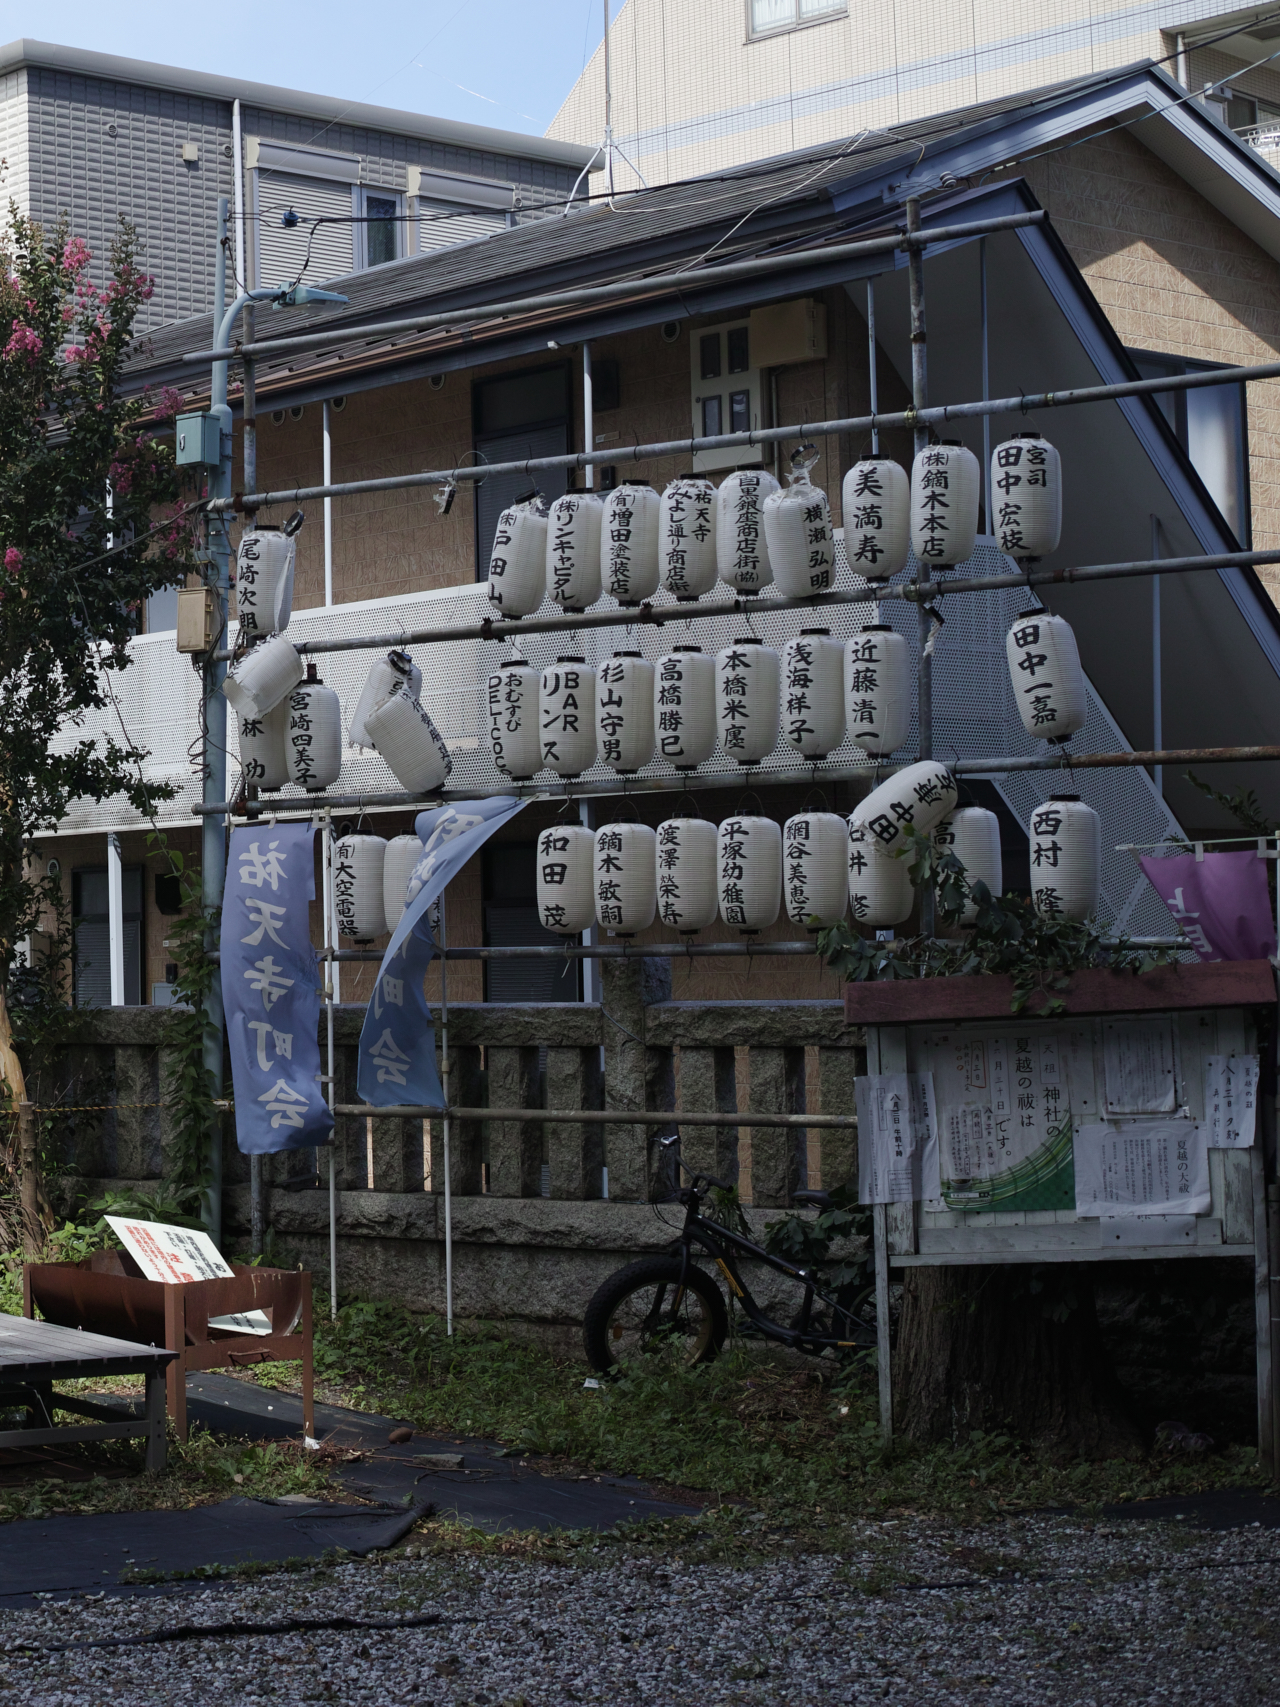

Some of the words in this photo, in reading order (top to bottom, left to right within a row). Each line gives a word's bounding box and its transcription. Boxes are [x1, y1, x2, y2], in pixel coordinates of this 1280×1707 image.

[1026, 445, 1048, 487] 宮司
[665, 486, 693, 593] みよし通り商店街
[691, 489, 713, 543] 祐天寺
[803, 504, 830, 590] 横瀬弘明
[853, 467, 884, 564] 美満寿
[504, 673, 523, 732] おむすび
[543, 672, 562, 762] リンス
[562, 671, 580, 733] BAR
[599, 663, 625, 762] 杉山守男
[785, 642, 815, 744] 浅海祥子
[850, 638, 881, 739] 近藤清一
[1012, 624, 1058, 727] 田中一嘉
[289, 691, 317, 783] 宮崎四美子
[540, 831, 570, 928] 和田茂
[721, 820, 750, 925] 平塚幼稚園
[1031, 809, 1064, 915] 西村隆
